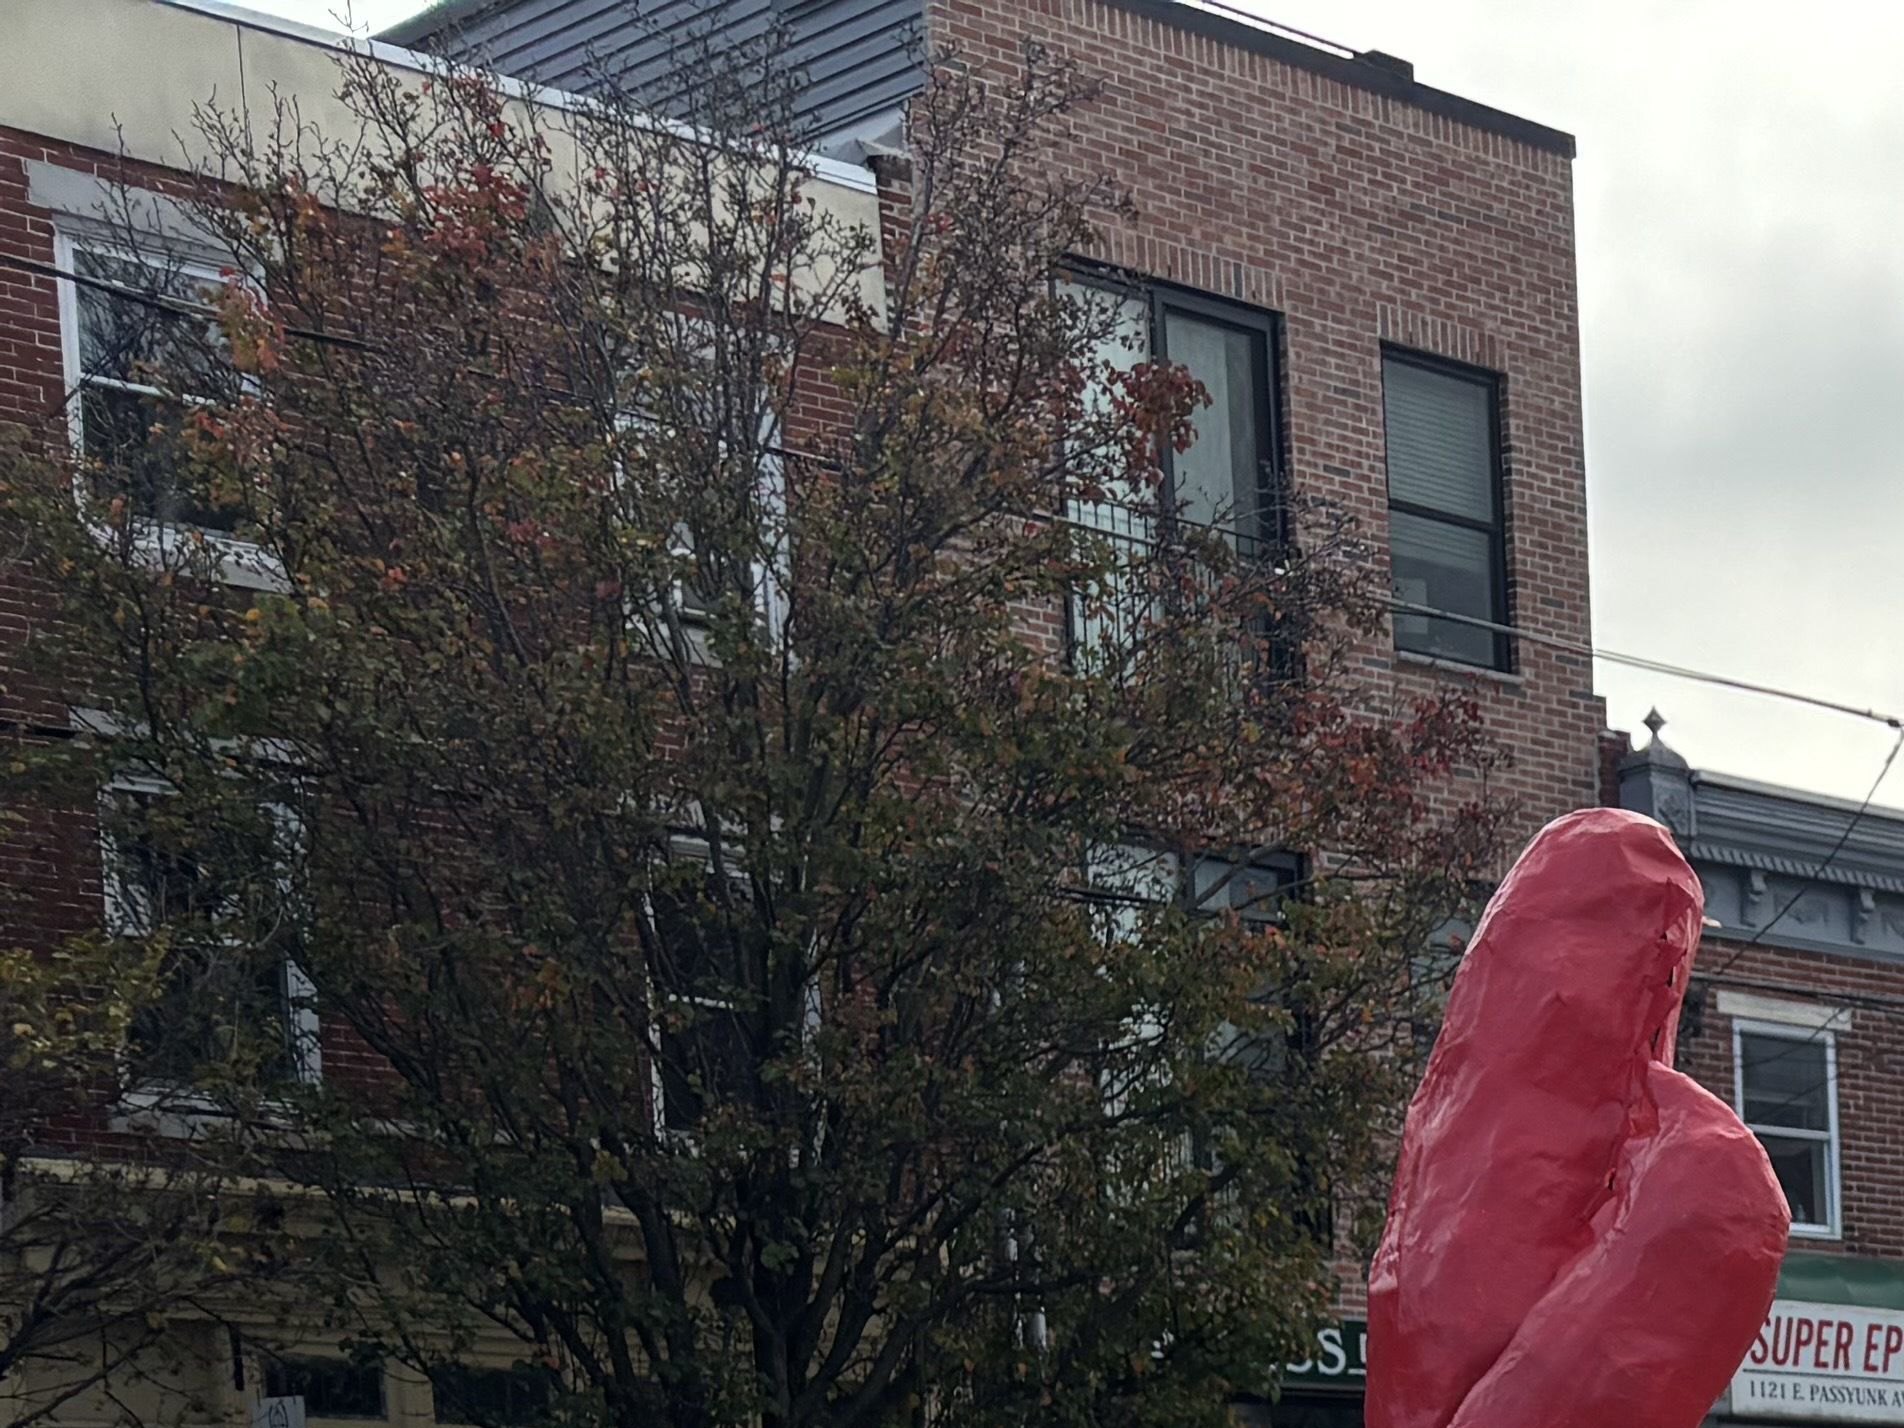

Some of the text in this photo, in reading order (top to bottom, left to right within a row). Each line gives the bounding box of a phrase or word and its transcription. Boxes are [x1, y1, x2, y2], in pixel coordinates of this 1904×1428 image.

[1750, 1315, 1854, 1371] SUPER
[1863, 1323, 1903, 1373] EP
[1749, 1380, 1786, 1400] 1121
[1810, 1383, 1889, 1407] PASSYUNK
